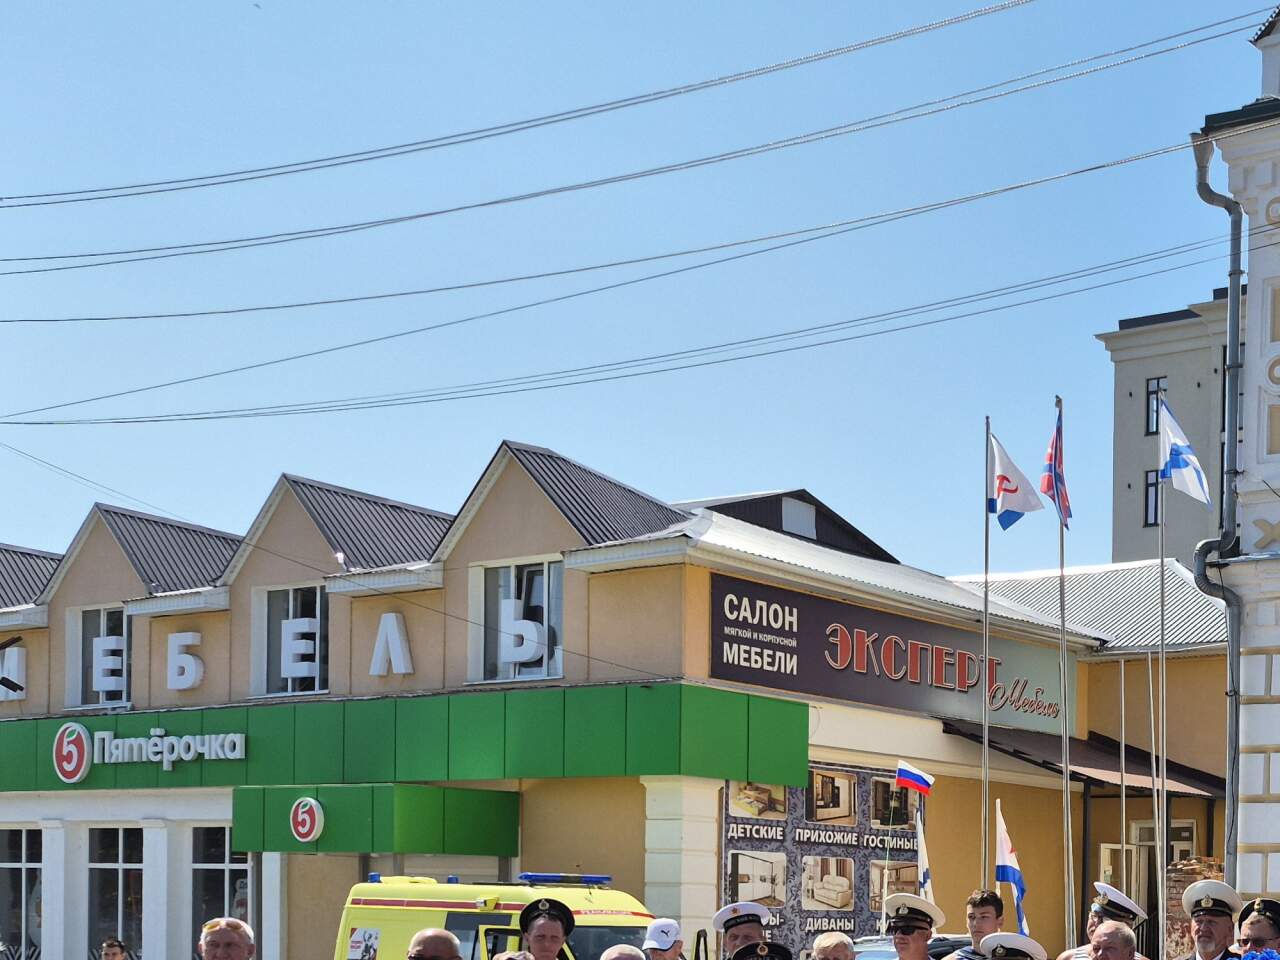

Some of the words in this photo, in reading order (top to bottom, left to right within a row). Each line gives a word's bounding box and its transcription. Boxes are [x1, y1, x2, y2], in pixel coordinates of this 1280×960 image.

[723, 593, 798, 632] САЛОН
[724, 625, 751, 639] МЯГКОЙ
[752, 632, 758, 640] И
[758, 633, 797, 648] КОРПУСНОЙ
[722, 641, 798, 676] МЕБЕЛИ
[824, 623, 1002, 692] ЭКСПЕРТ
[987, 677, 1061, 719] Мебель
[93, 728, 246, 771] Пятёрочка
[727, 823, 785, 840] ДЕТСКИЕ
[795, 828, 858, 846] ПРИХОЖИЕ
[863, 834, 919, 851] ГОСТИНЫЕ
[805, 917, 855, 933] ДИВАНЫ
